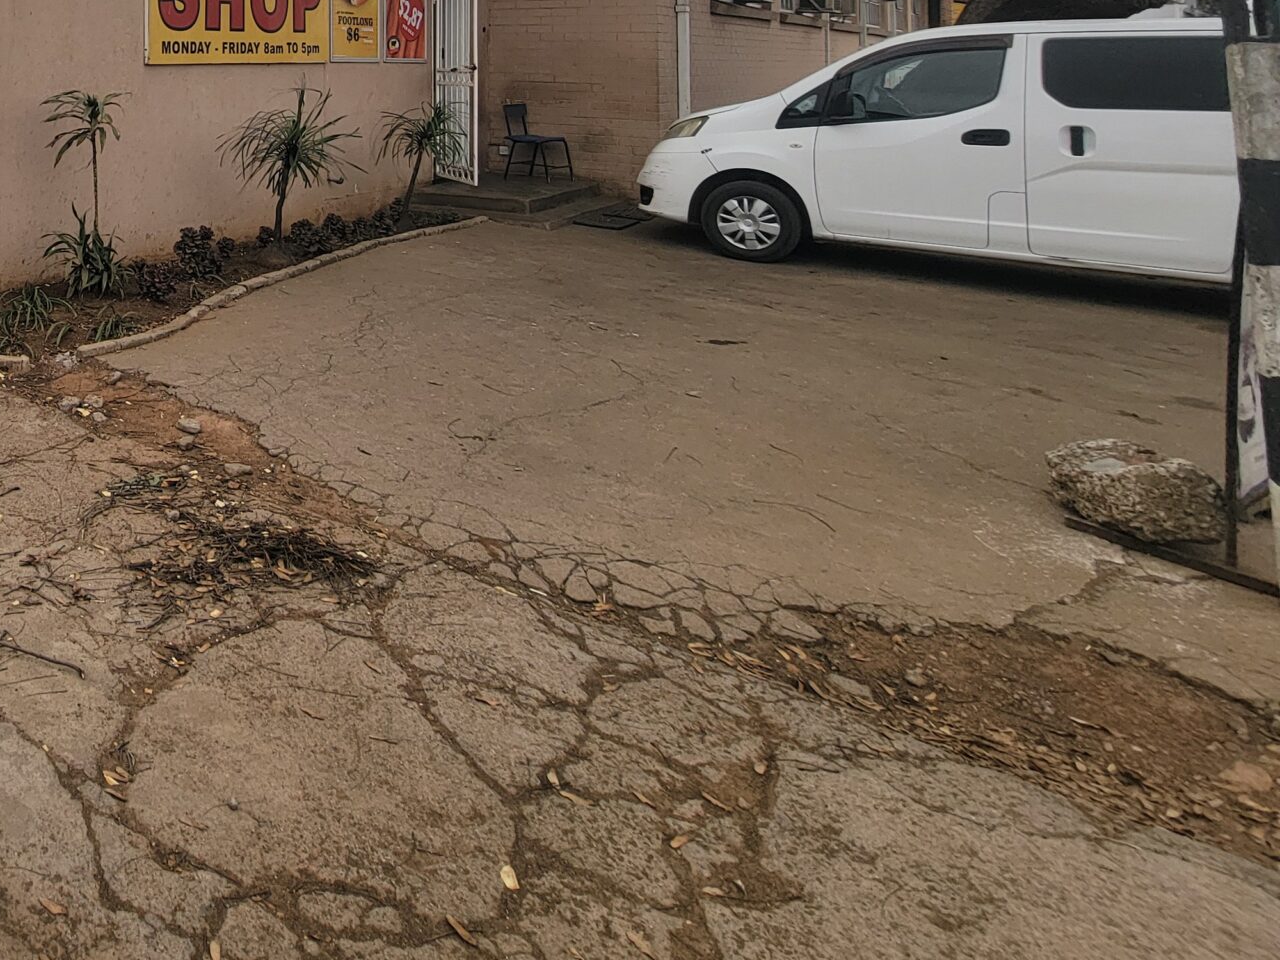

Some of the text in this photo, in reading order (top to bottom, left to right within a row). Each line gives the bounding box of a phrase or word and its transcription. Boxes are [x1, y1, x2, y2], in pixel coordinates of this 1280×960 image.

[337, 15, 373, 27] FOOTLONG
[346, 27, 359, 44] $6
[161, 41, 211, 54] MONDAY
[222, 42, 260, 54] FRIDAY
[263, 42, 284, 54] 8am
[287, 42, 299, 54] TO
[301, 43, 320, 56] 5pm
